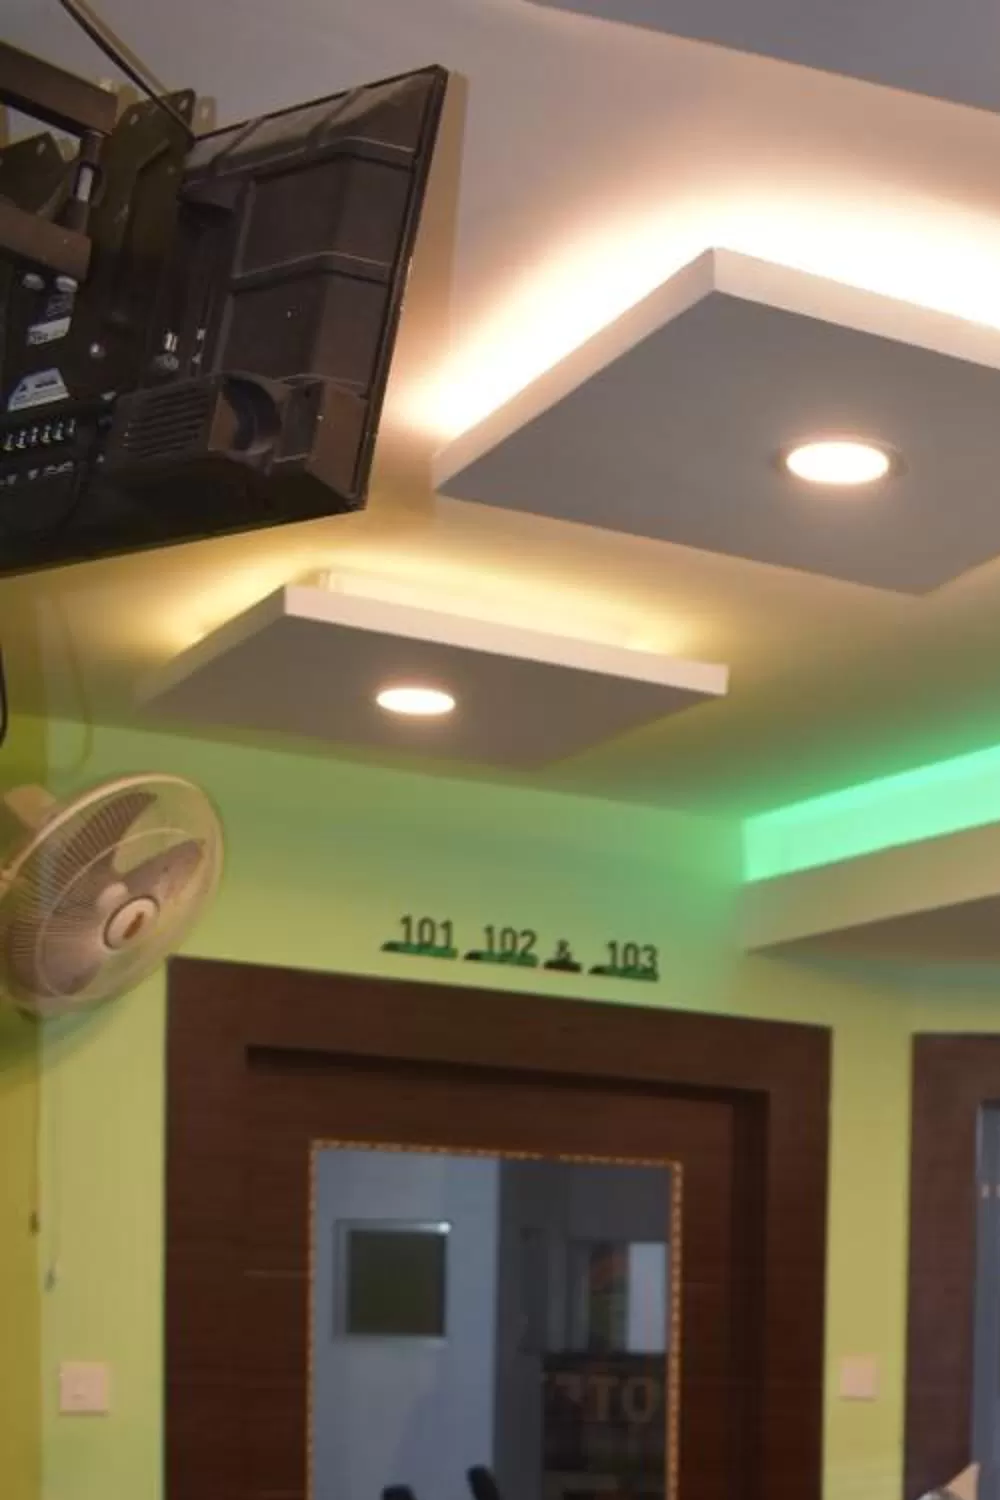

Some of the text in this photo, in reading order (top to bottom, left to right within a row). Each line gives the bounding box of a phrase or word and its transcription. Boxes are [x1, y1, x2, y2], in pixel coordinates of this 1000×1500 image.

[398, 914, 456, 953] 101
[482, 925, 539, 961] 102
[604, 941, 660, 976] 103
